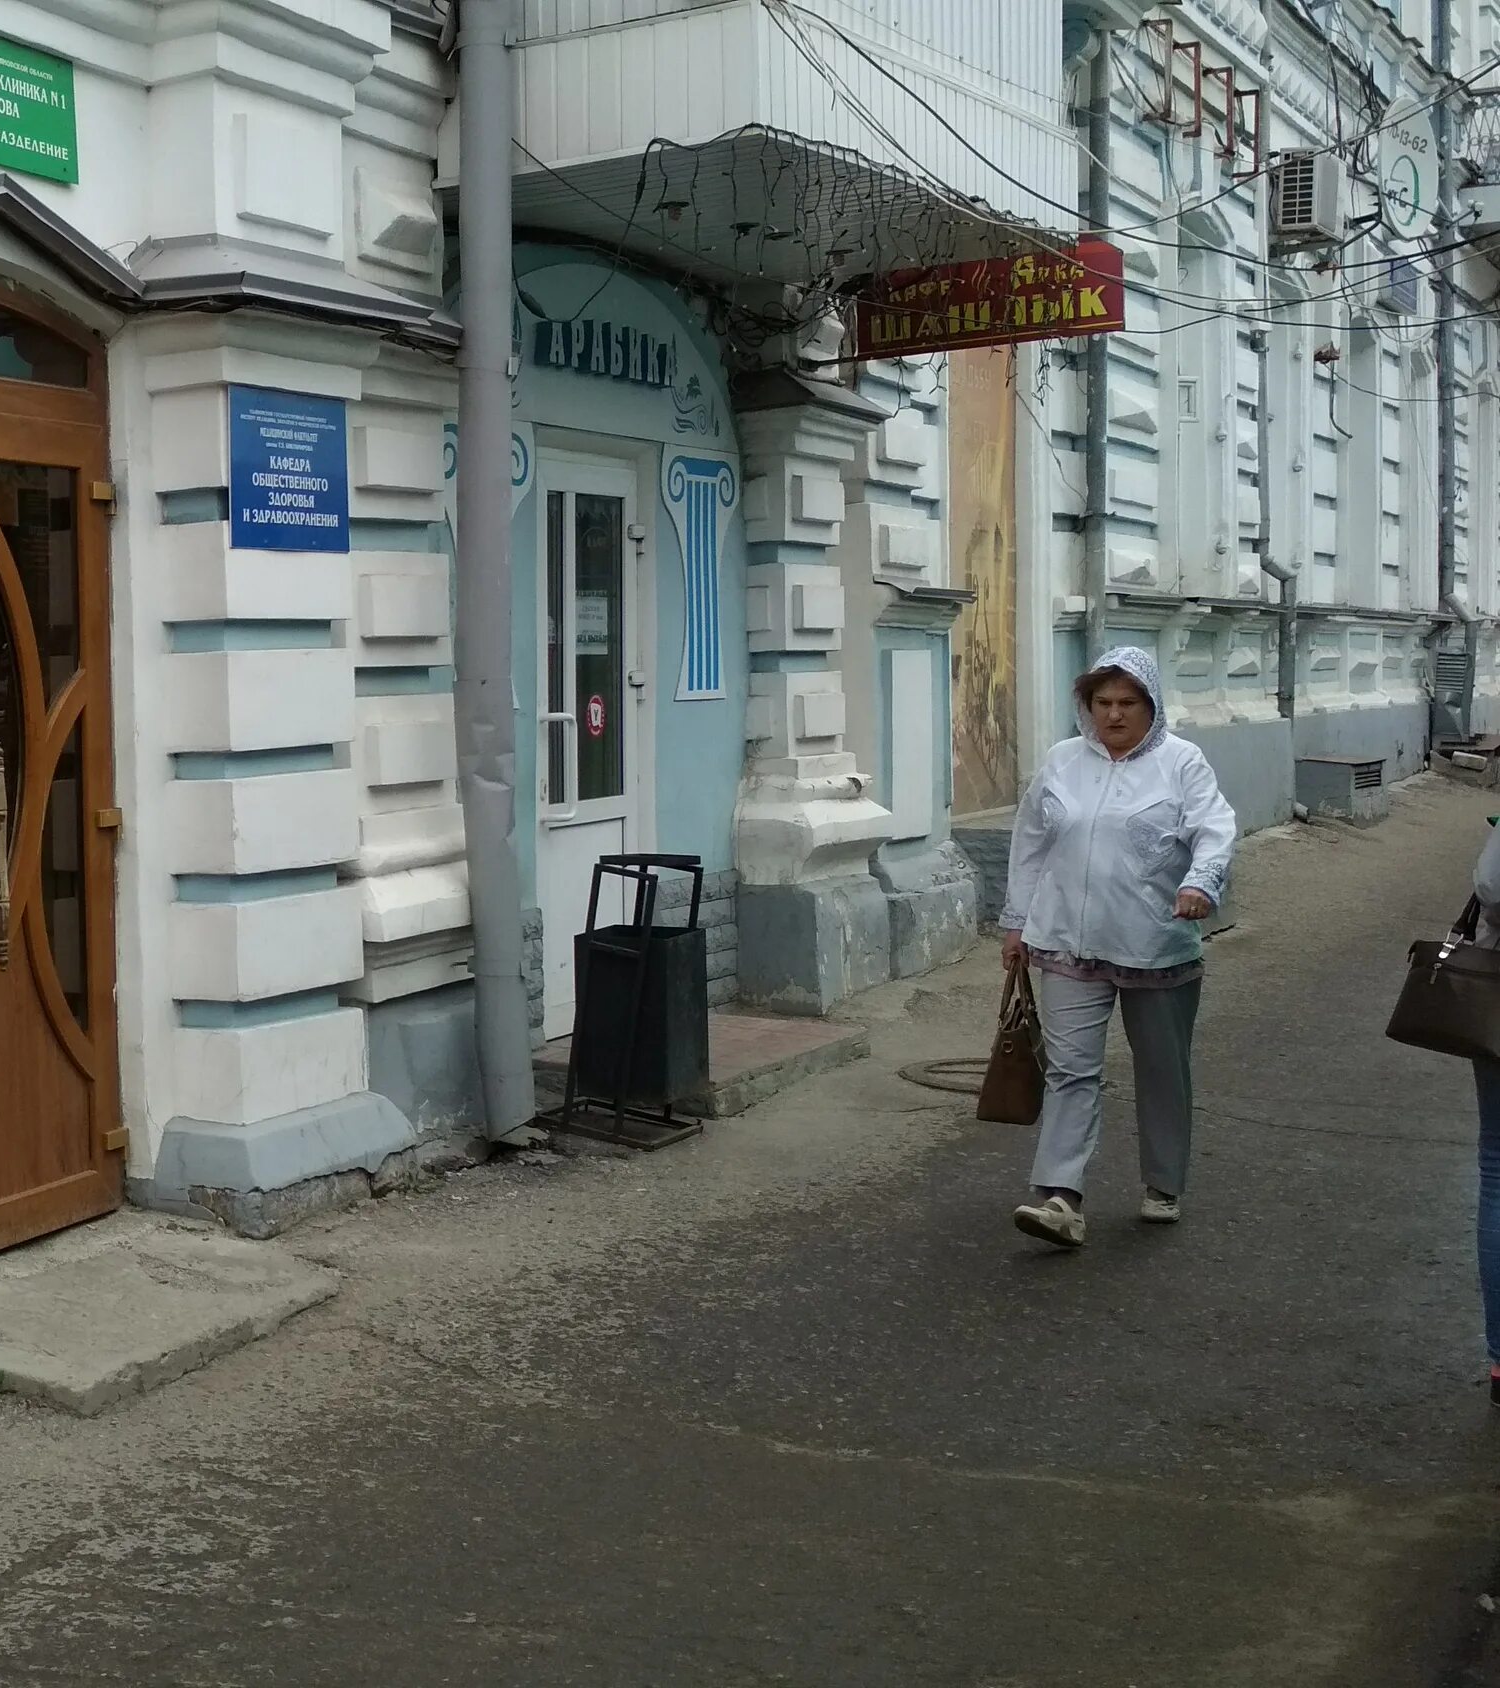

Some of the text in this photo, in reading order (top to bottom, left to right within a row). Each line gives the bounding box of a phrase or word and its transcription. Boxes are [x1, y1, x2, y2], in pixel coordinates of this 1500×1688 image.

[60, 94, 66, 110] 1
[870, 285, 1108, 344] ШАШЛЫК
[548, 320, 678, 387] АРАБИКА
[269, 455, 311, 473] КАФЕДРА
[252, 472, 329, 492] ОБЩЕСТВЕННОГО
[268, 491, 315, 508] ЗДОРОВЬЯ
[243, 508, 339, 527] И ЗДРАВООХРАНЕНИЯ
